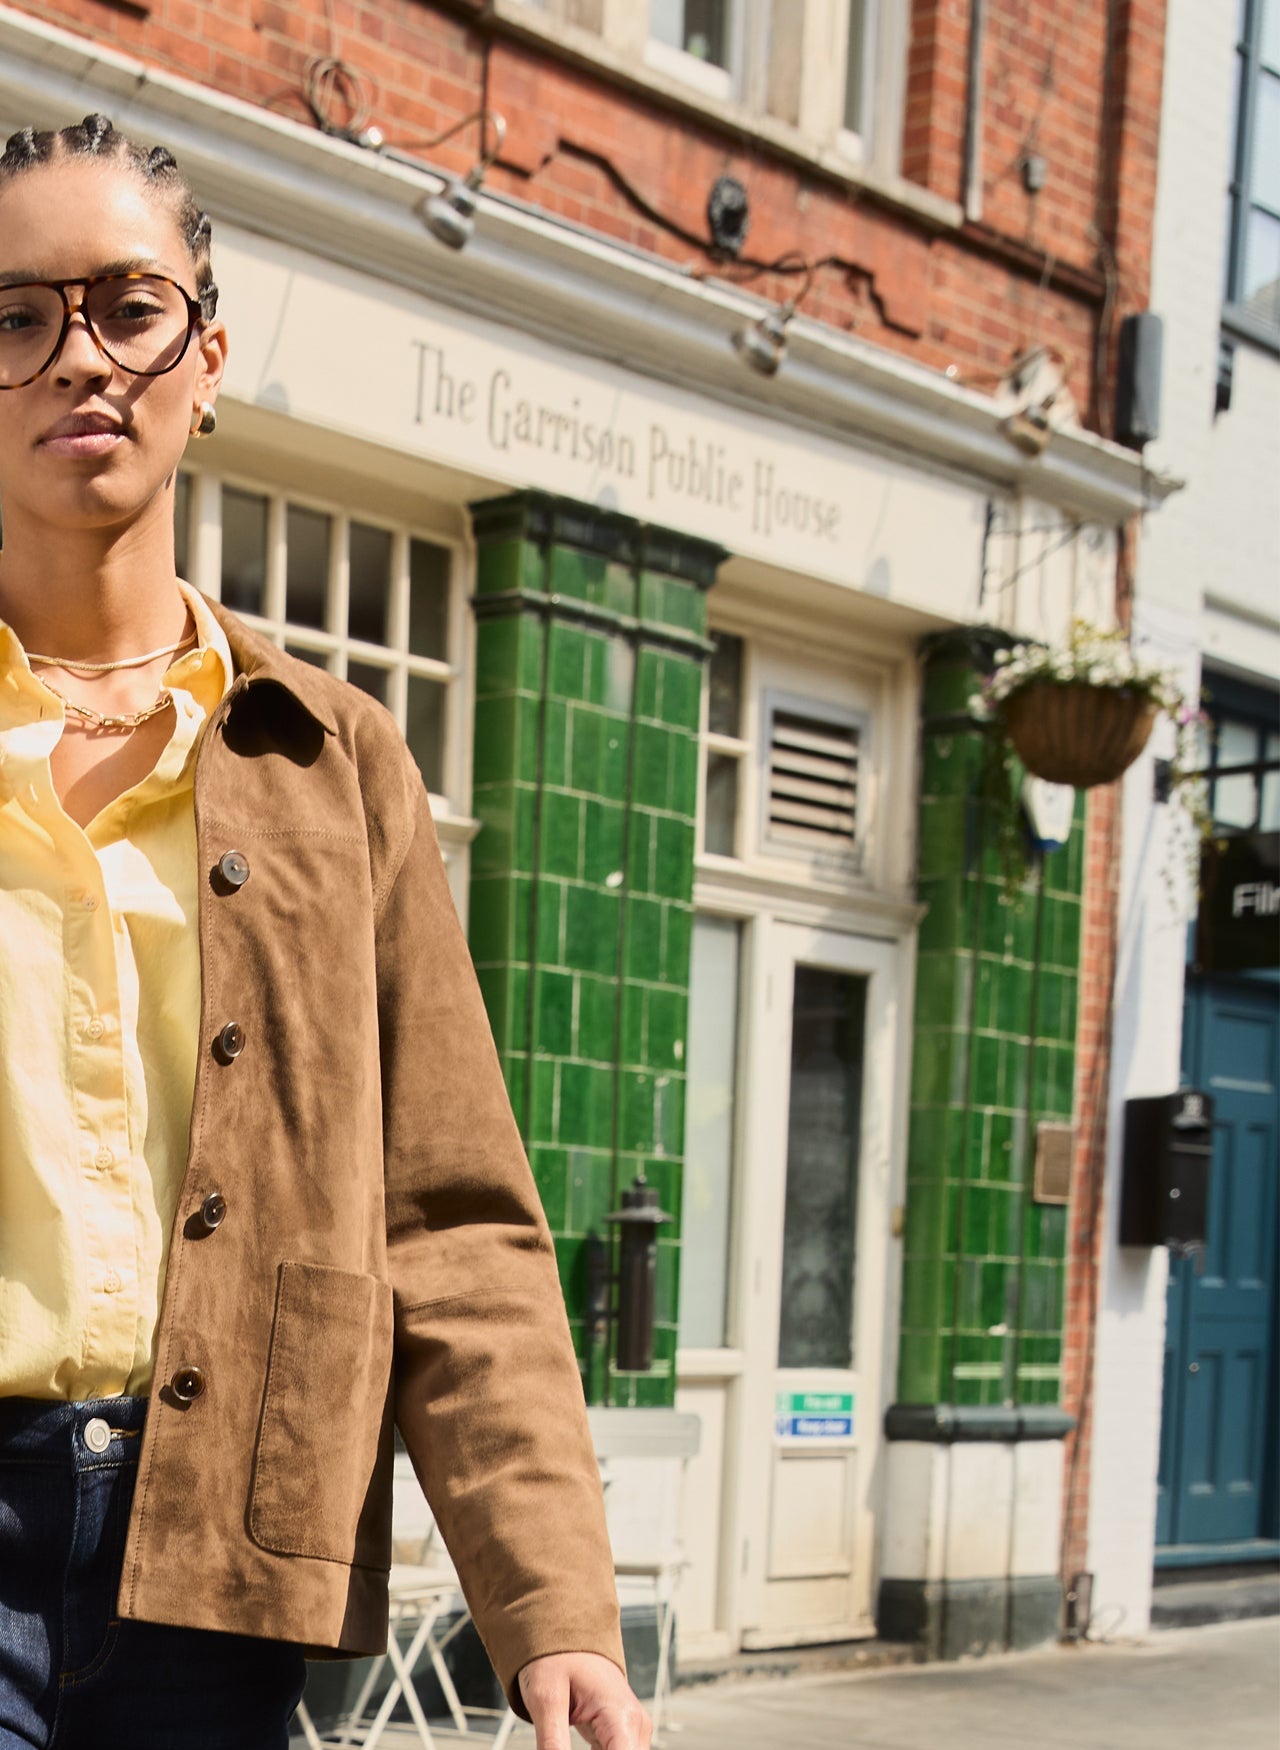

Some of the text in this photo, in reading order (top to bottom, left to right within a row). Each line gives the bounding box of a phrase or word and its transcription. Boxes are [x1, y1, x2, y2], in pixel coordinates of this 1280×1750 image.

[411, 338, 842, 543] The Garrison Public House
